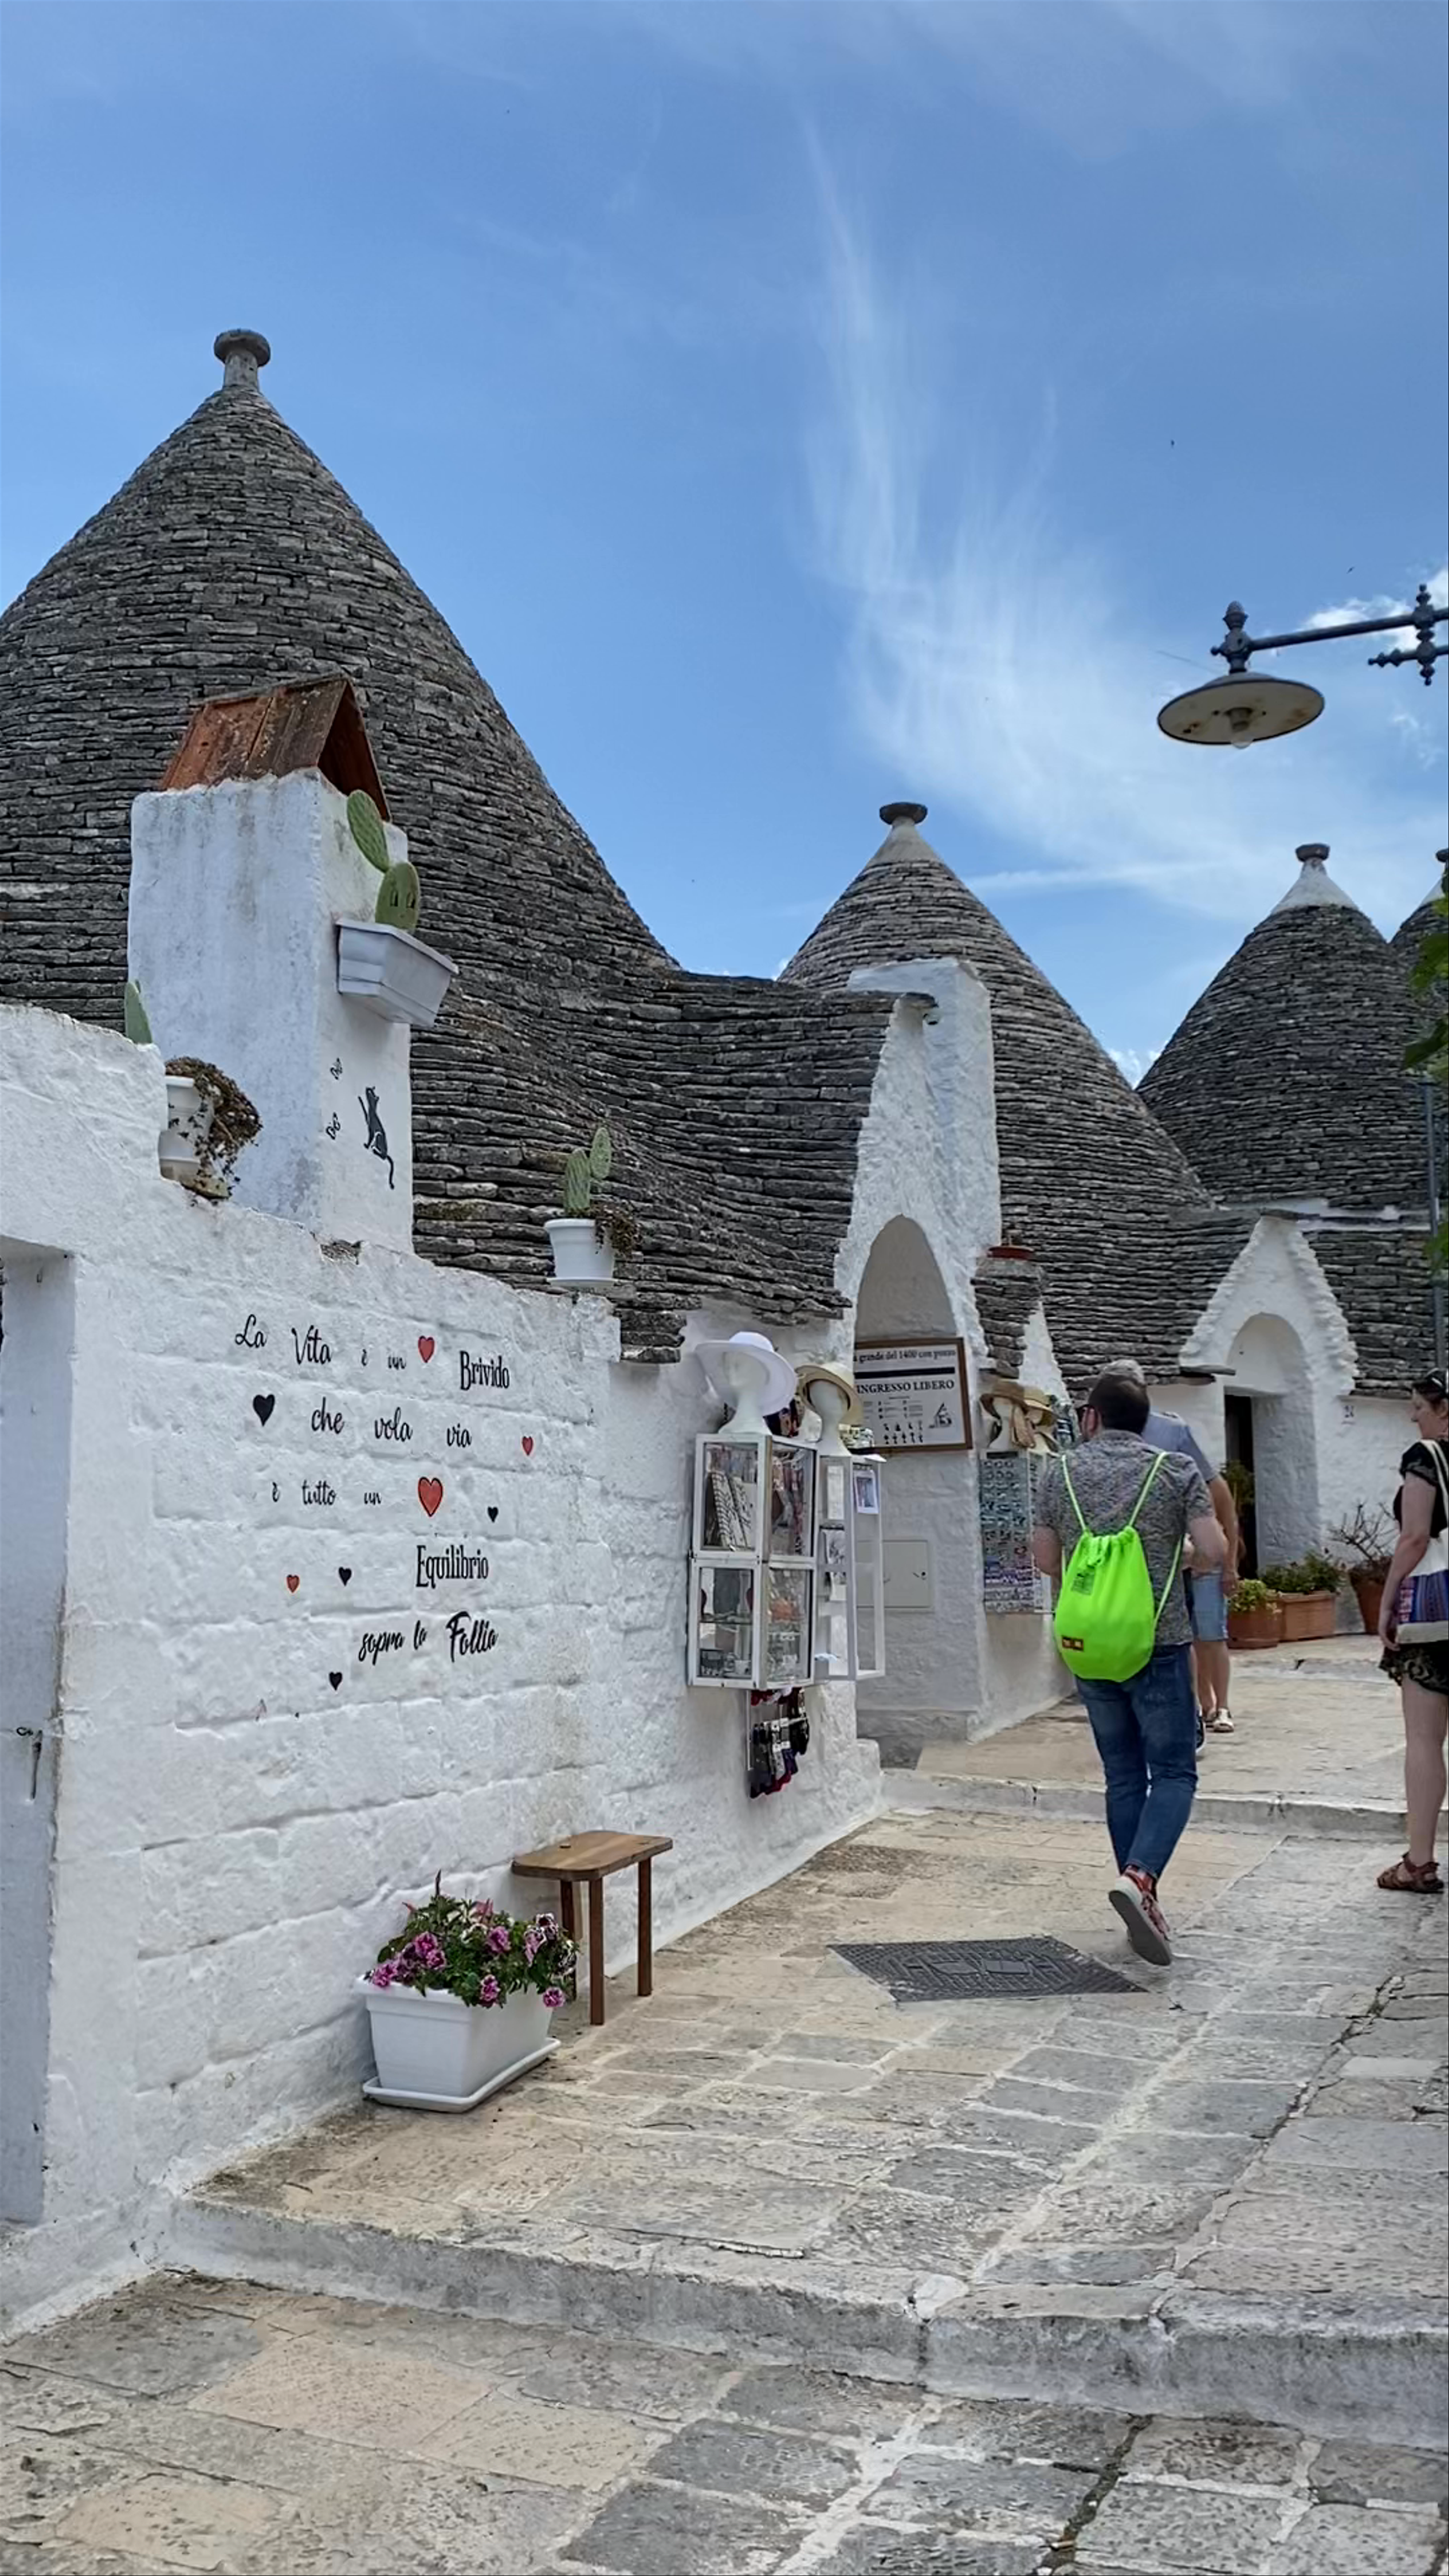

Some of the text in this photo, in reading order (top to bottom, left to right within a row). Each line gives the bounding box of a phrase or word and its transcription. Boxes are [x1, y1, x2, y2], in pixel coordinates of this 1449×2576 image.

[234, 1314, 267, 1349] La
[291, 1324, 331, 1365] Vita
[388, 1356, 407, 1370] un
[459, 1350, 510, 1391] Brivido
[857, 1380, 954, 1393] INGRESSO LIBERO
[311, 1396, 472, 1448] che vola via
[301, 1479, 337, 1506] tutto
[364, 1492, 381, 1506] un
[415, 1544, 489, 1589] Equilibrio
[358, 1610, 499, 1666] sopra la Follia
